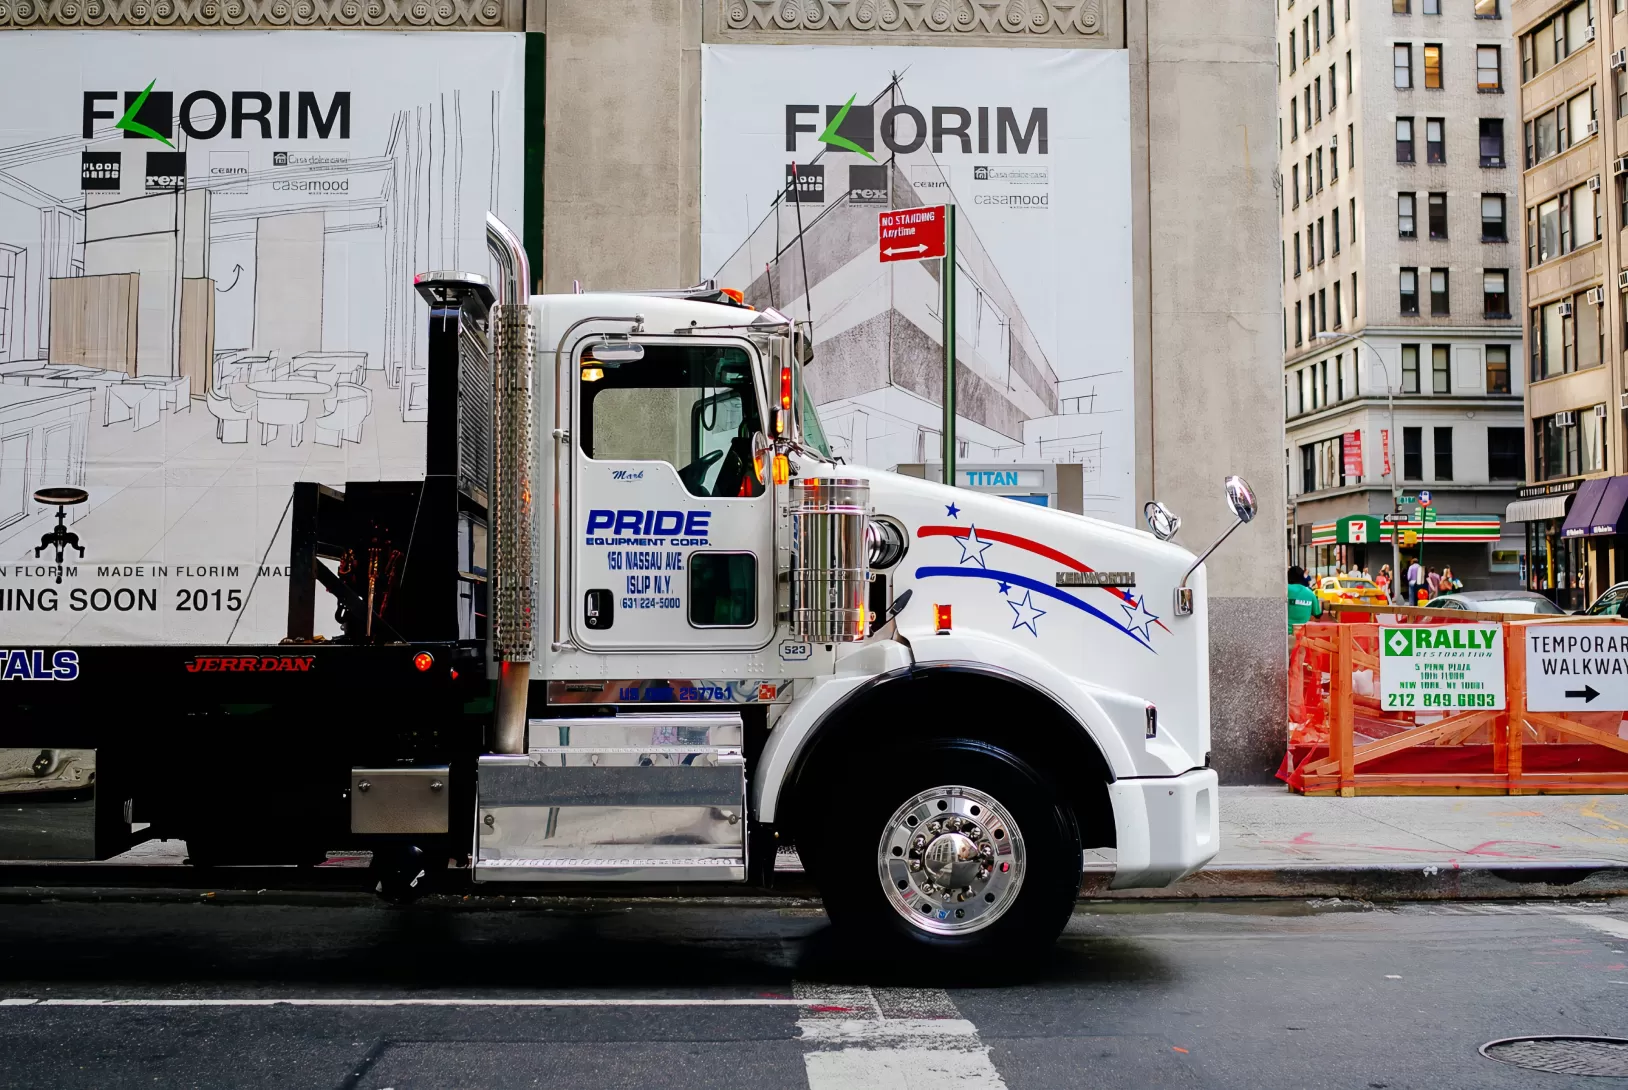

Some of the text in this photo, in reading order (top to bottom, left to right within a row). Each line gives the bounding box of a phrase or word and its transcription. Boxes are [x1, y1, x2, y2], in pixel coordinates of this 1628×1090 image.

[272, 178, 349, 191] casamood
[850, 189, 887, 199] rex
[974, 192, 1049, 205] casamood
[882, 211, 935, 227] NO STANDING
[966, 471, 1018, 486] TITAN
[586, 509, 711, 536] PRIDE
[586, 538, 712, 546] EQUIPMENT CORP.
[607, 551, 622, 570] 150
[626, 551, 662, 570] NASSAU
[97, 566, 144, 577] MADE
[152, 566, 168, 577] IN
[176, 566, 239, 577] FLORIM
[1056, 572, 1136, 584] KENWORTH
[626, 575, 650, 594] ISLIP
[69, 588, 157, 612] SOON
[176, 588, 242, 612] 2015
[1415, 629, 1497, 649] RALLY
[785, 645, 806, 655] 523
[679, 686, 732, 701] 257761
[1388, 693, 1415, 707] 212
